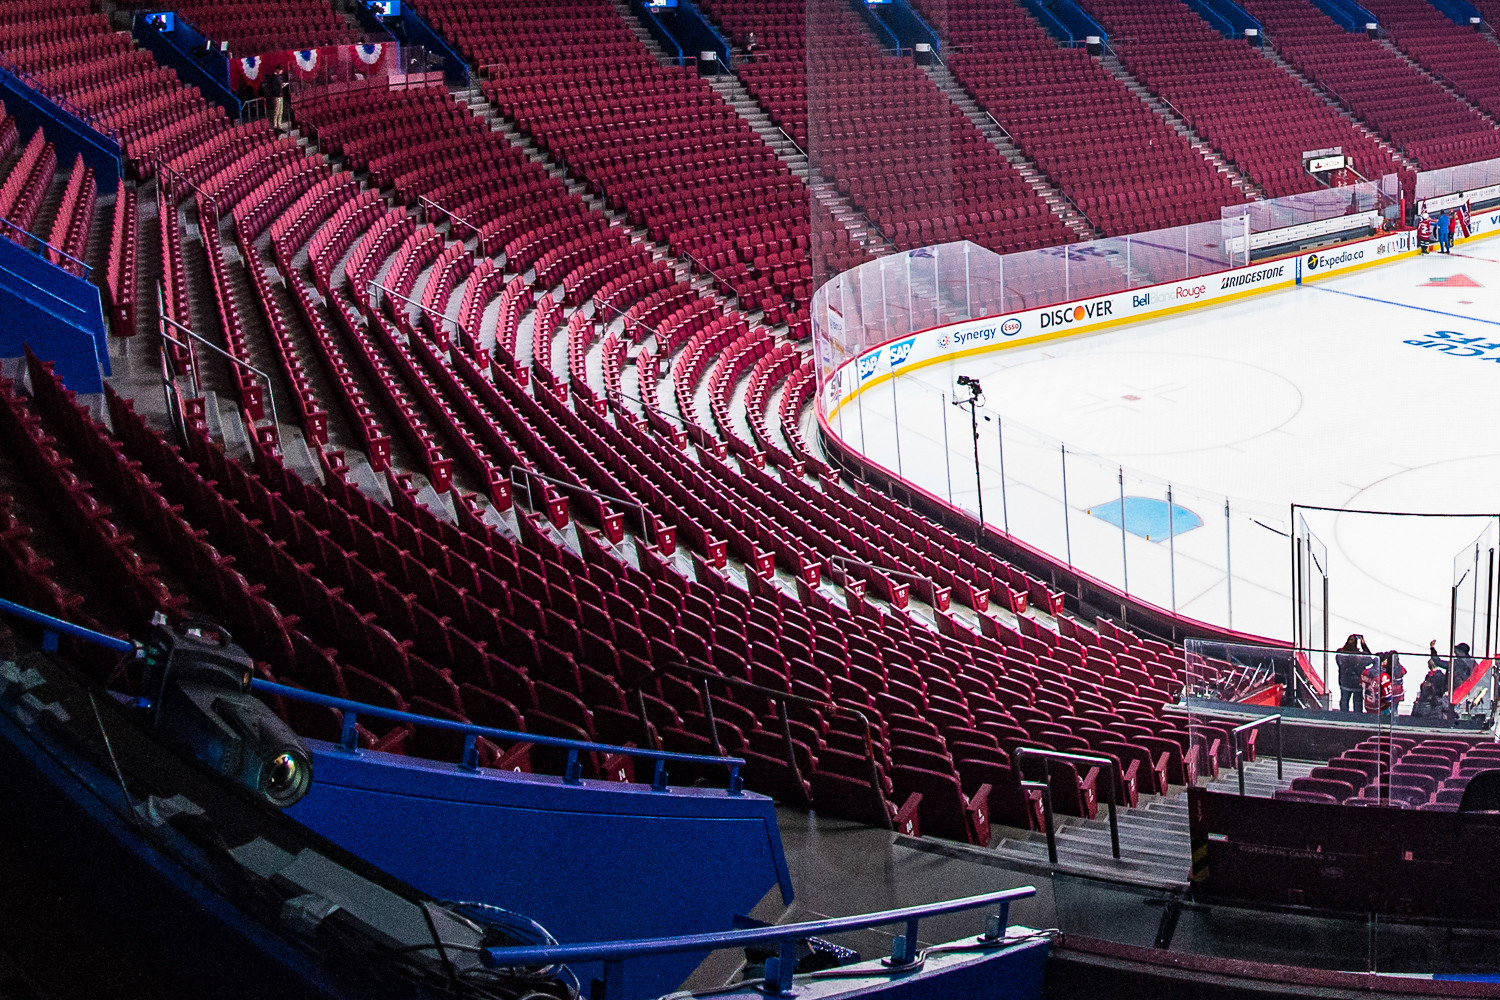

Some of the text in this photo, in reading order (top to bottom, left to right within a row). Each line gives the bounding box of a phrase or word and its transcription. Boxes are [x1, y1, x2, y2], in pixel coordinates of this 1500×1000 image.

[1319, 249, 1364, 269] Expedia.ca
[1220, 266, 1285, 290] BRIDGESTONE
[1132, 293, 1150, 308] Bell
[1175, 284, 1206, 300] Rouge
[1040, 300, 1113, 329] DISCOVER
[953, 326, 997, 346] Synergy
[1003, 323, 1020, 332] Esso
[890, 343, 911, 364] SAP
[1402, 338, 1486, 358] CUP
[860, 356, 879, 379] SAP
[618, 768, 626, 781] N
